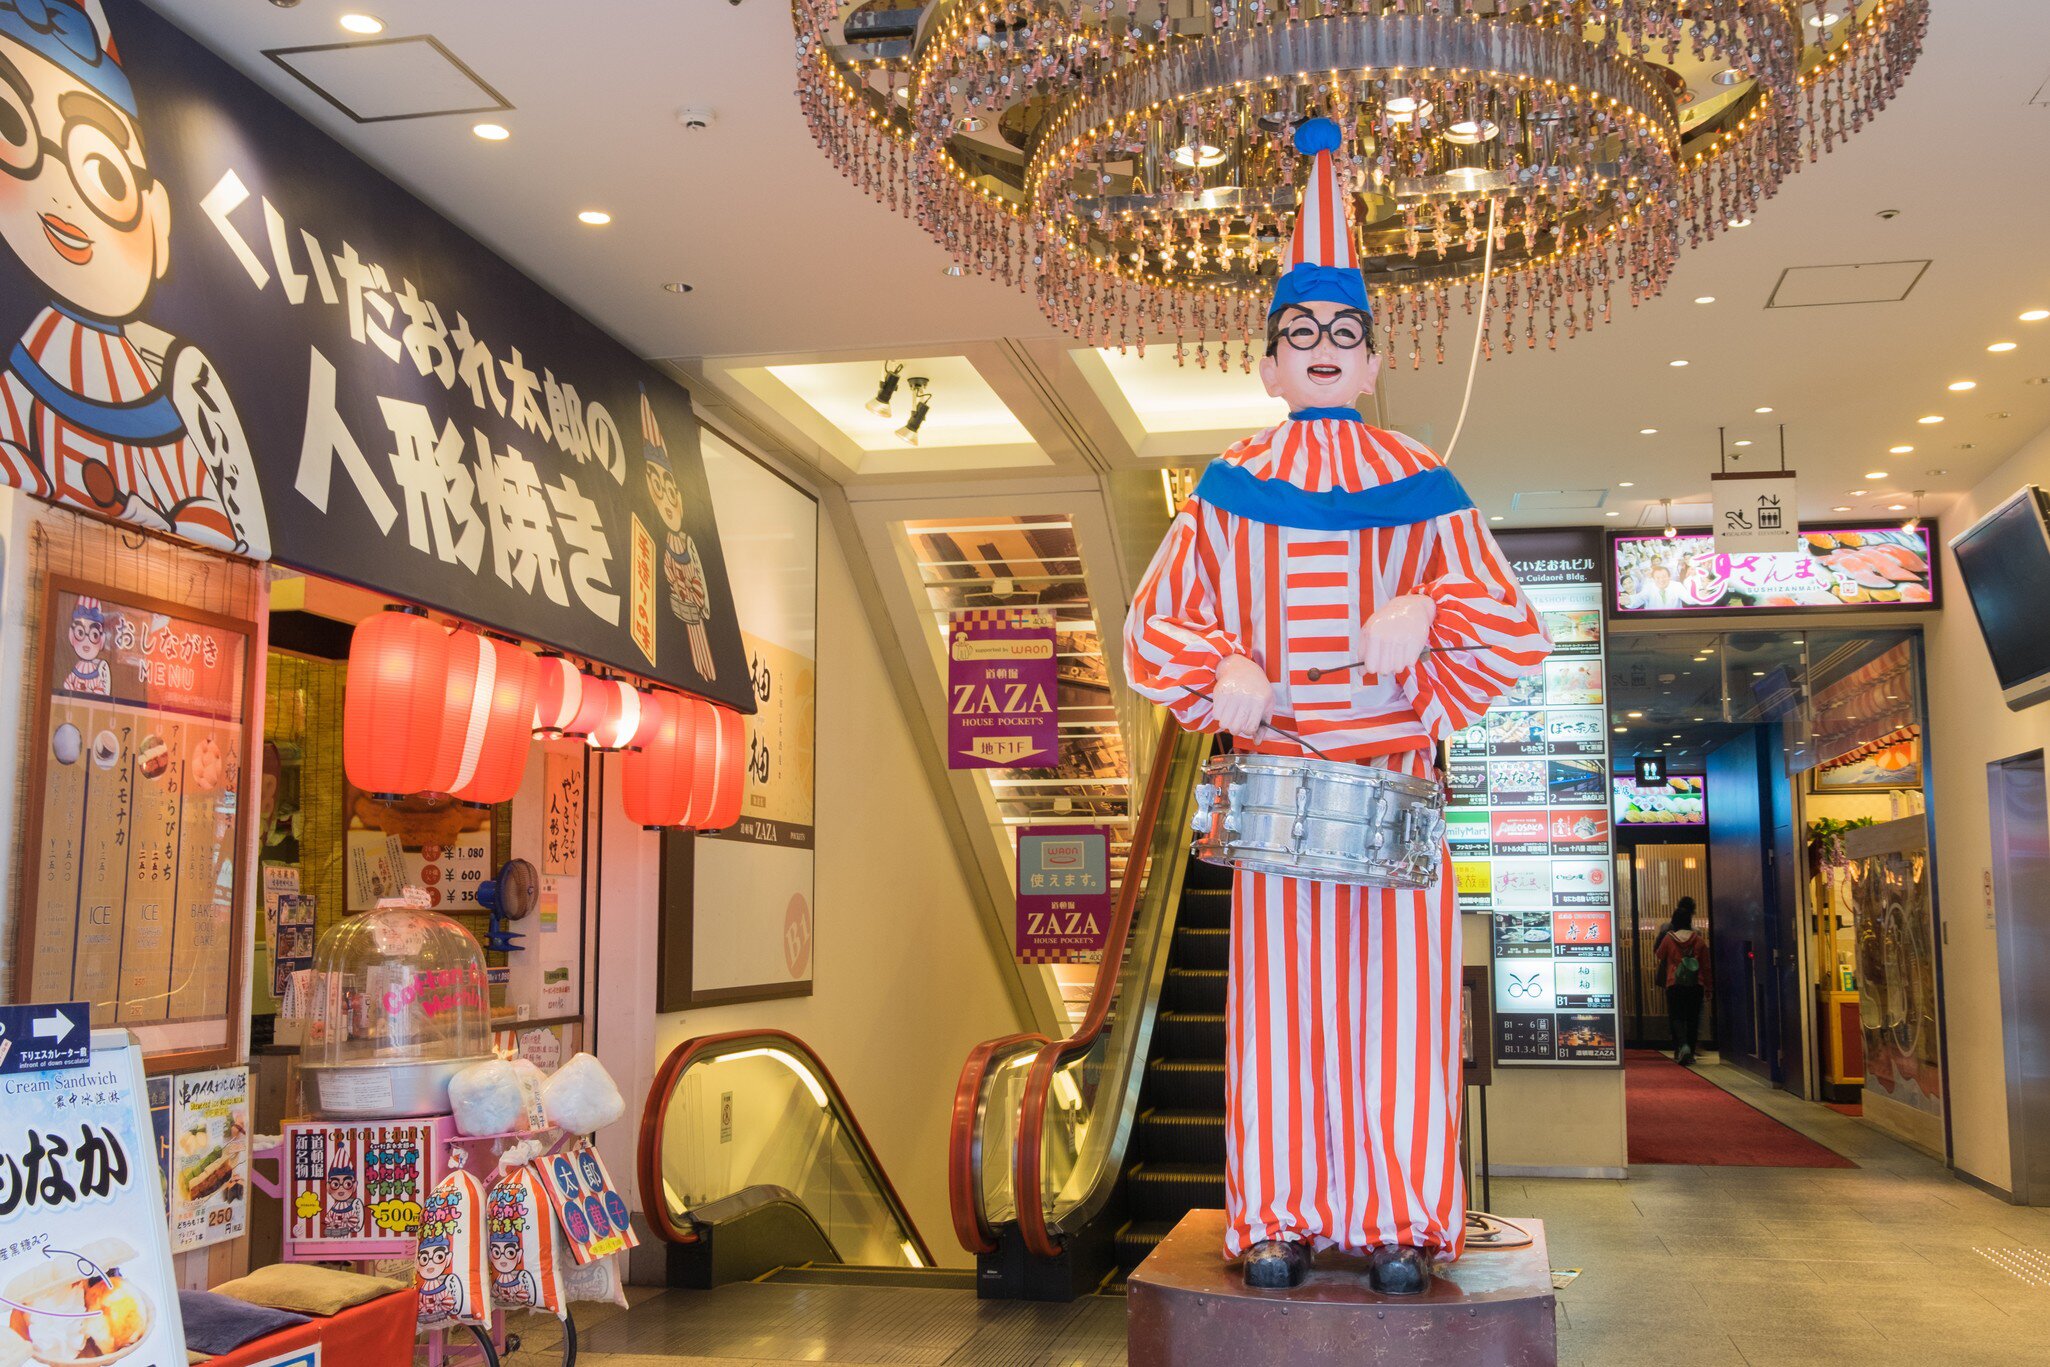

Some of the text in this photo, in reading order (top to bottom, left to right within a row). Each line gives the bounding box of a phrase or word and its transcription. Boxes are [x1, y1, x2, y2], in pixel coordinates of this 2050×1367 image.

[200, 168, 626, 486] くいだおれ太郎の
[295, 345, 621, 627] 人形焼き
[1508, 558, 1595, 572] くいだおれビル
[115, 616, 219, 669] おしながき
[138, 658, 195, 691] MENU
[952, 683, 1054, 715] ZAZA
[962, 718, 994, 727] HOUSE
[981, 741, 1025, 756] 地下1F
[1490, 745, 1497, 754] 3
[1549, 744, 1556, 753] 3
[115, 726, 131, 847] アイスモナカ
[163, 725, 179, 881] アイスわらびもち
[1491, 794, 1498, 804] 3
[1550, 793, 1557, 803] 2
[755, 821, 777, 842] ZAZA
[1047, 847, 1079, 855] WAON
[461, 870, 482, 881] 600
[1030, 873, 1097, 888] 使えます。
[89, 905, 112, 925] ICE
[141, 904, 159, 921] ICE
[1026, 913, 1101, 935] ZAZA
[1496, 946, 1503, 956] 2
[1554, 945, 1567, 955] 1F
[382, 967, 463, 1017] Cotton
[1556, 996, 1569, 1006] B1
[1529, 1020, 1536, 1028] 6
[1504, 1033, 1513, 1041] B1
[20, 1046, 88, 1062] 下りエスカレーター前
[1559, 1048, 1569, 1058] B1
[5, 1070, 118, 1095] Cream Sandwich
[328, 1126, 430, 1141] cotton candy
[295, 1135, 309, 1179] 新名物
[310, 1135, 325, 1179] 道頓堀
[365, 1148, 420, 1166] わたしが
[365, 1165, 420, 1181] わたがし
[559, 1160, 602, 1194] 太郎
[208, 1206, 233, 1228] 250
